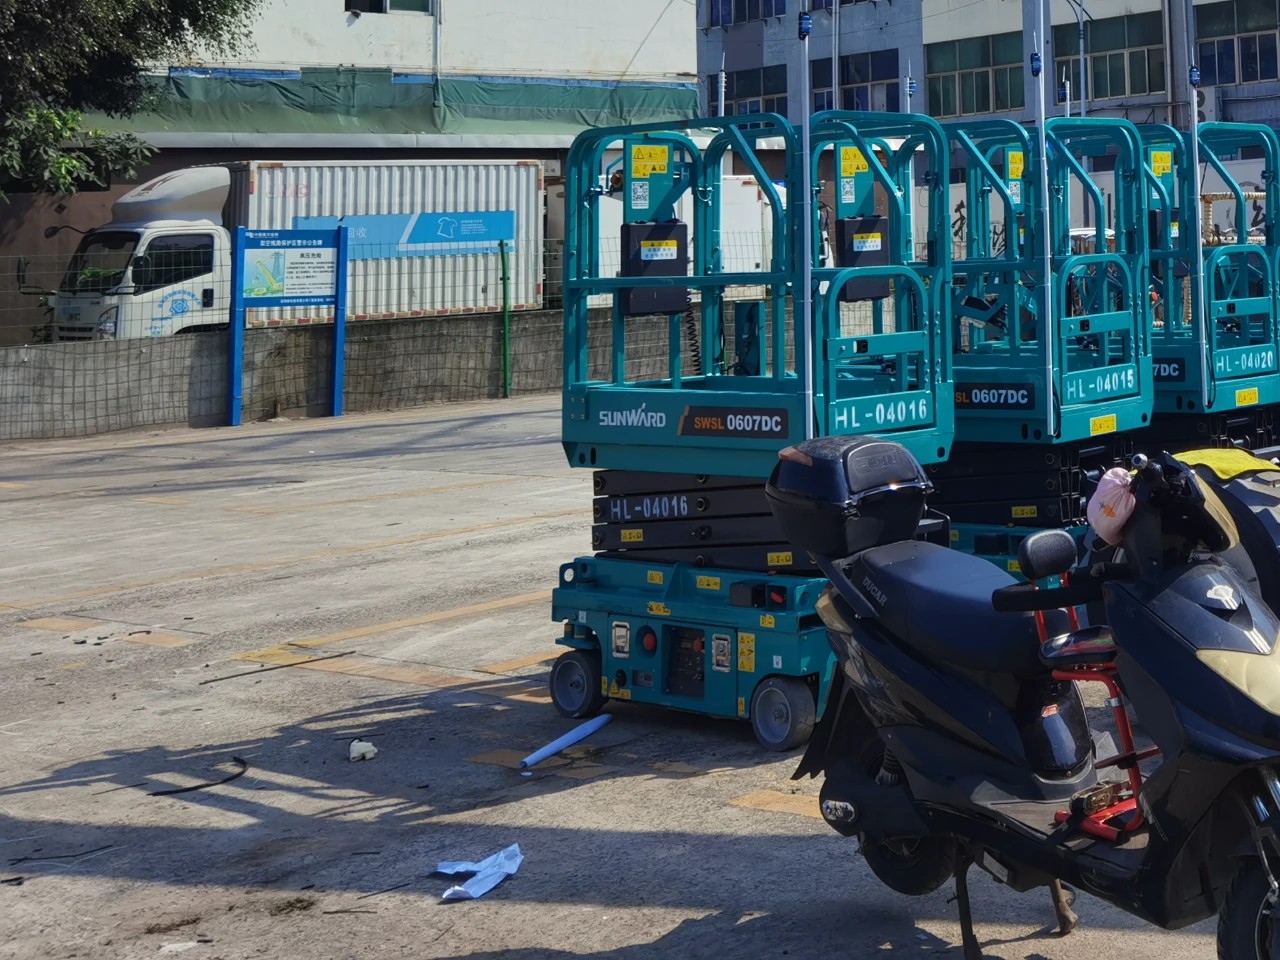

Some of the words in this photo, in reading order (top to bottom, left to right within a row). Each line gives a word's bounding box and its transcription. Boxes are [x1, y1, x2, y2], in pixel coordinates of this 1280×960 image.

[971, 388, 1029, 404] 0607DC
[599, 403, 666, 428] SUNWARD
[694, 415, 725, 430] SWSL
[727, 414, 782, 432] 0607DC
[835, 399, 928, 430] HL-04016
[610, 495, 688, 520] HL-04016
[862, 575, 888, 607] DUCAR
